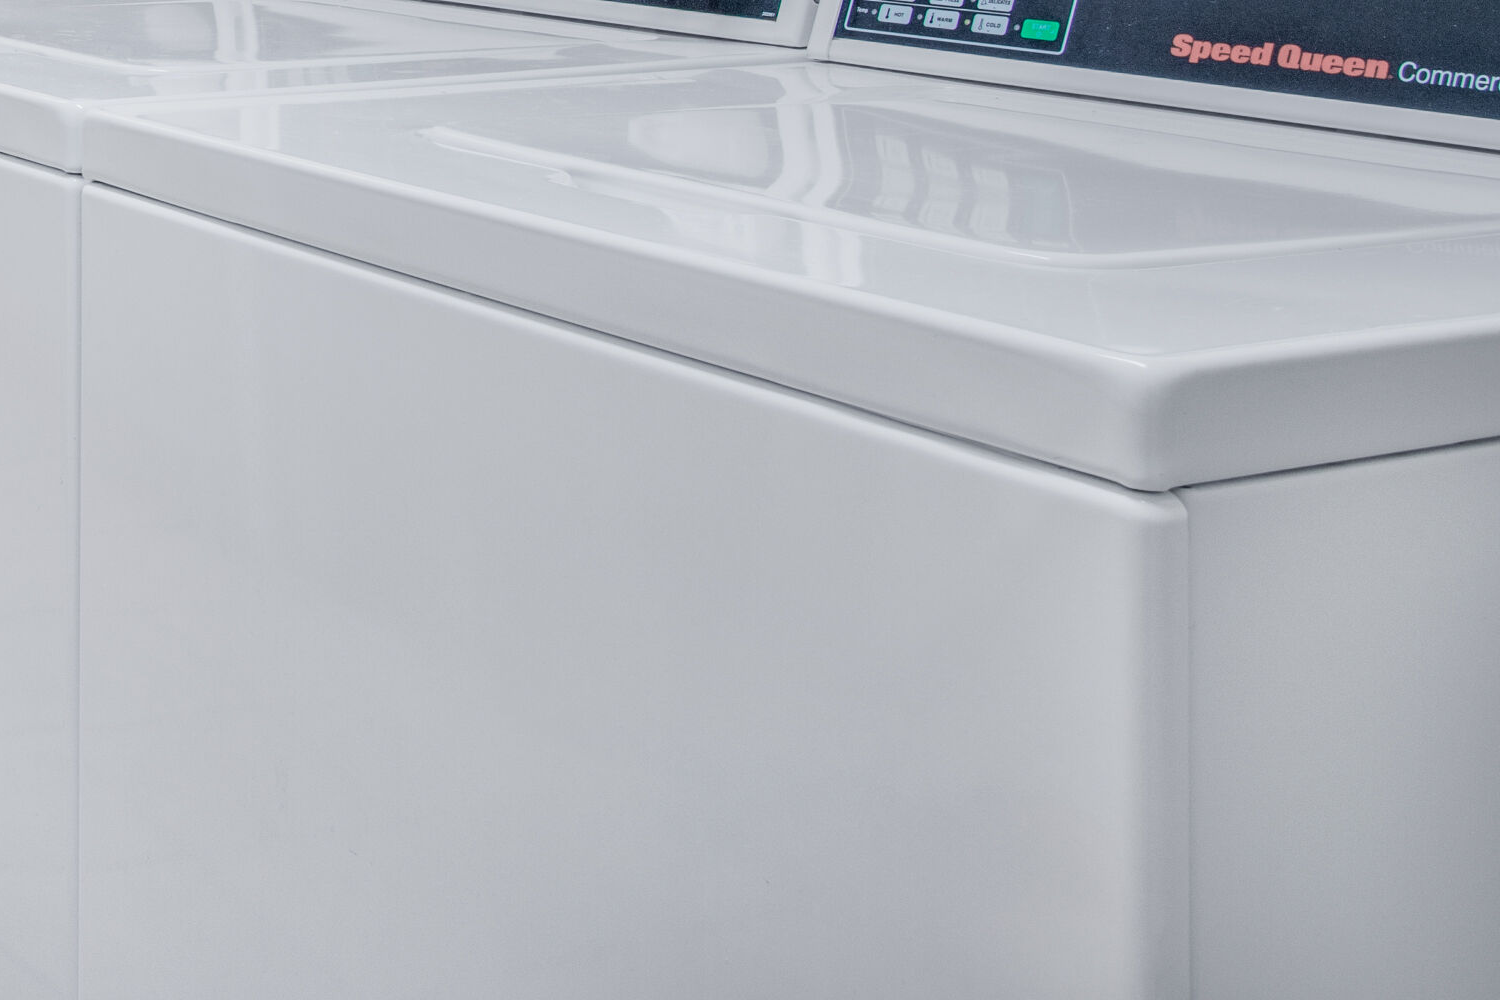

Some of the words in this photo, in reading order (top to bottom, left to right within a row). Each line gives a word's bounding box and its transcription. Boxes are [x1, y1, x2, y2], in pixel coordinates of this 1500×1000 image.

[1170, 33, 1275, 64] Speed
[1277, 44, 1390, 79] Queen
[1398, 61, 1500, 92] Commer
